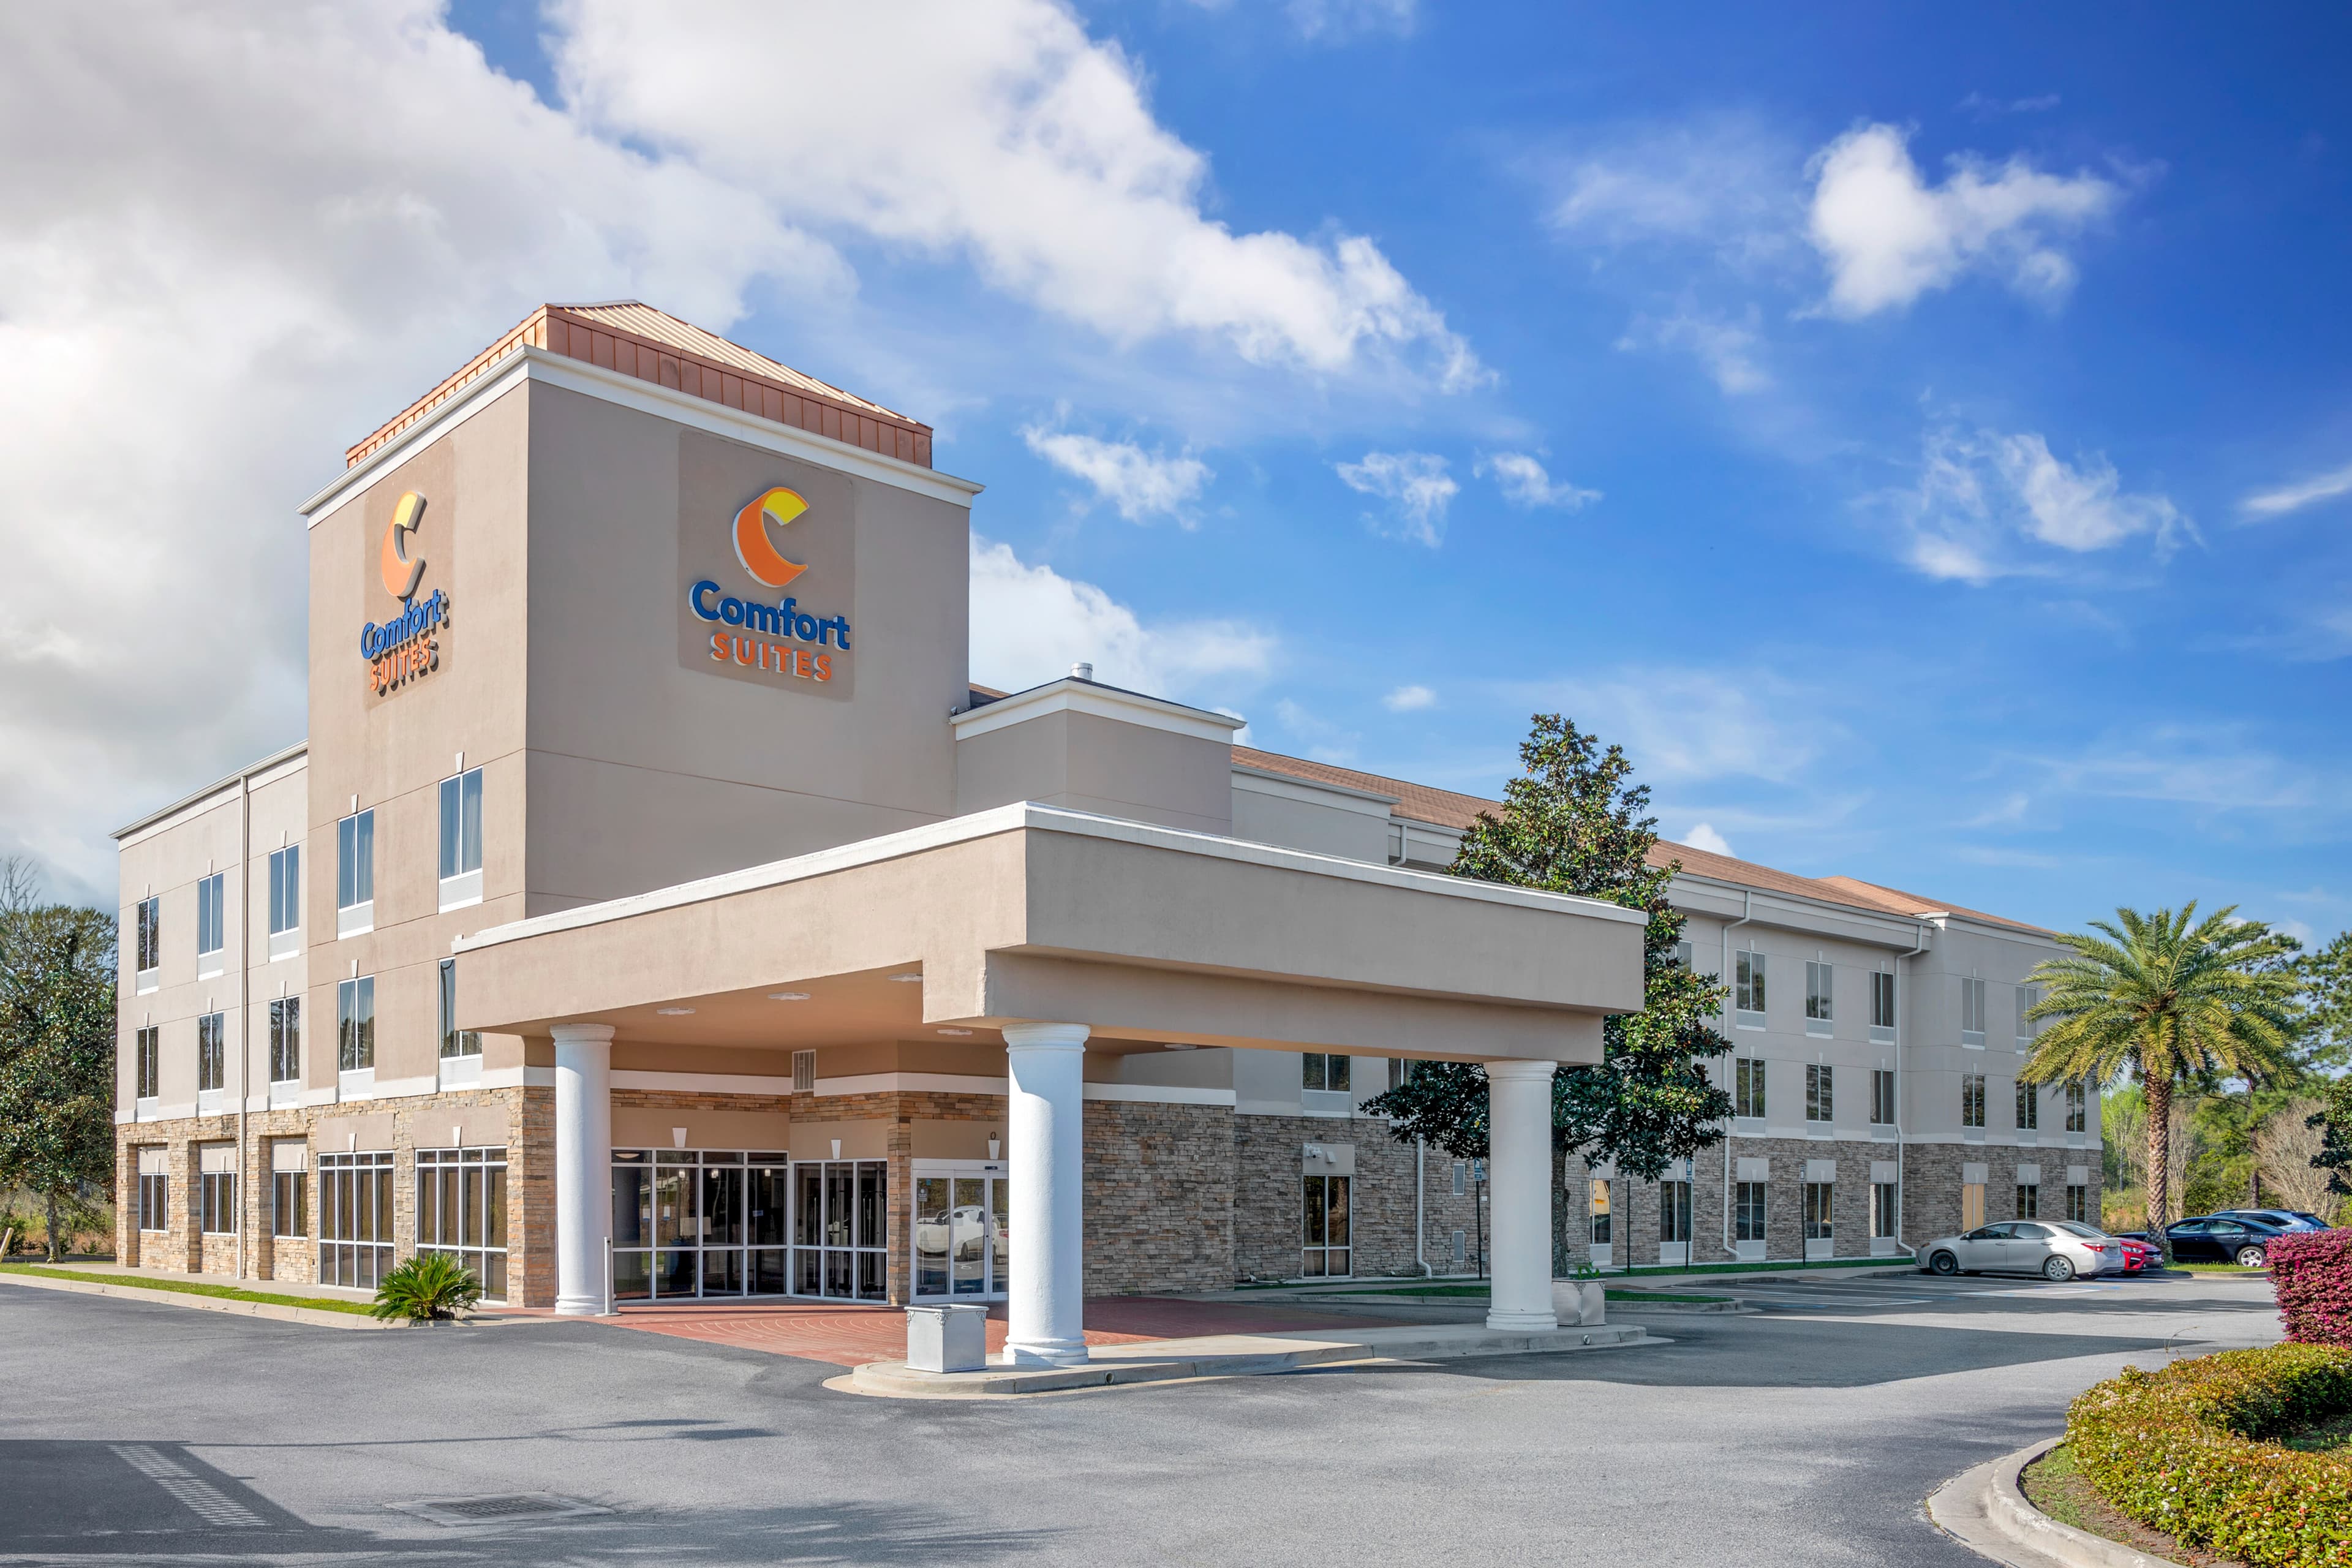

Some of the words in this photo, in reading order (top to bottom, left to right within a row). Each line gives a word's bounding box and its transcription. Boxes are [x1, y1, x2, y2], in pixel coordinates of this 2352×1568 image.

[361, 588, 445, 659] Comfort
[688, 580, 850, 650] Comfort
[369, 638, 435, 691] SUITES
[710, 632, 832, 682] SUITES
